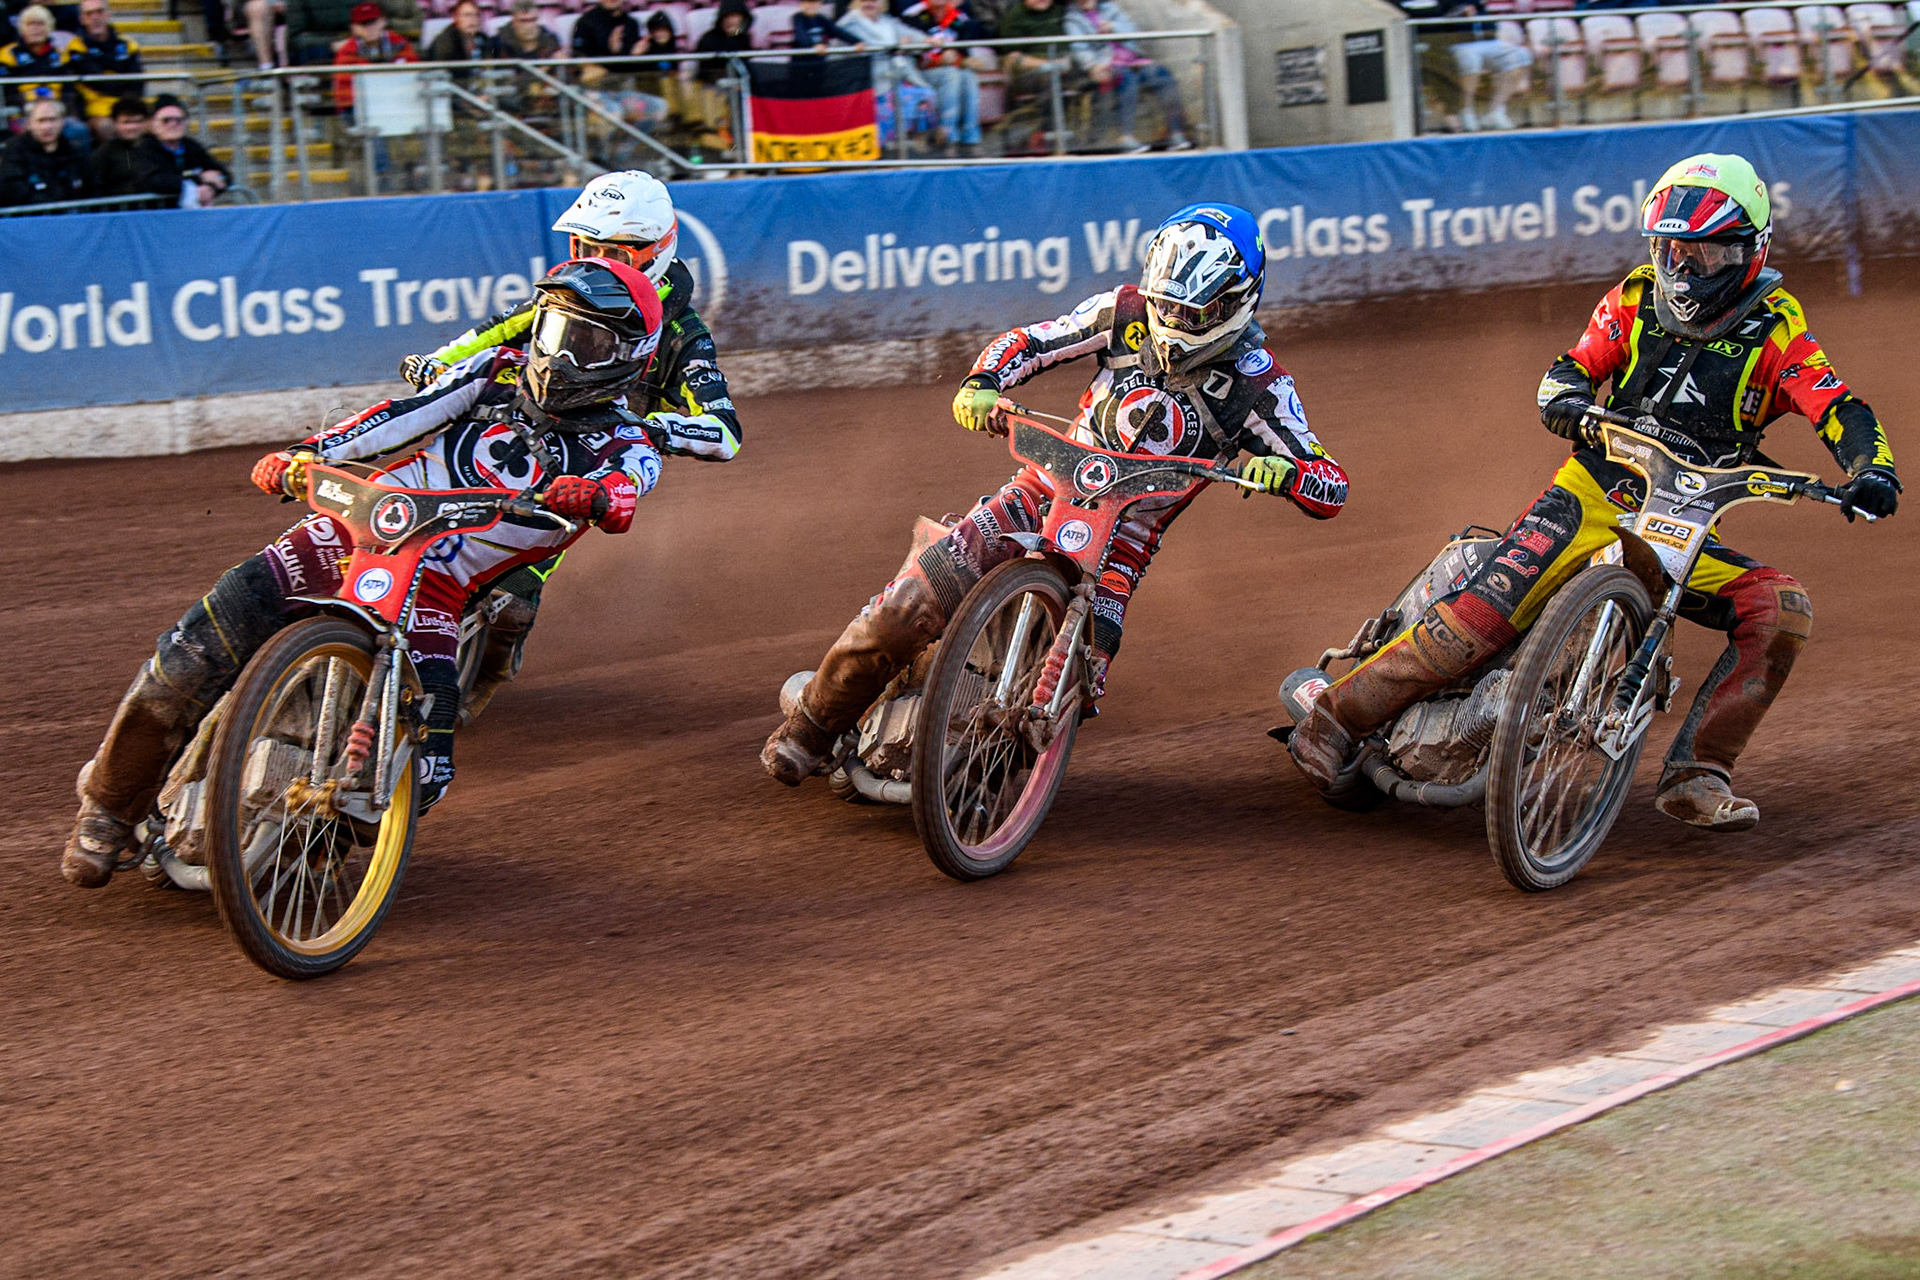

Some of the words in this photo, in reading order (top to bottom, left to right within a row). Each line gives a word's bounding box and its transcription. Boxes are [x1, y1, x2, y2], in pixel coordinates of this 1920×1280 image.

[1259, 205, 1390, 260] Class
[1402, 187, 1557, 248] Travel
[1659, 222, 1684, 230] BELL
[788, 226, 1070, 295] Delivering
[0, 282, 150, 354] orld
[172, 276, 345, 340] Class
[359, 257, 545, 327] Travel
[1122, 377, 1157, 393] BELLE
[1181, 404, 1198, 437] ACES
[1063, 530, 1086, 542] ATPI
[1646, 518, 1692, 540] JCB
